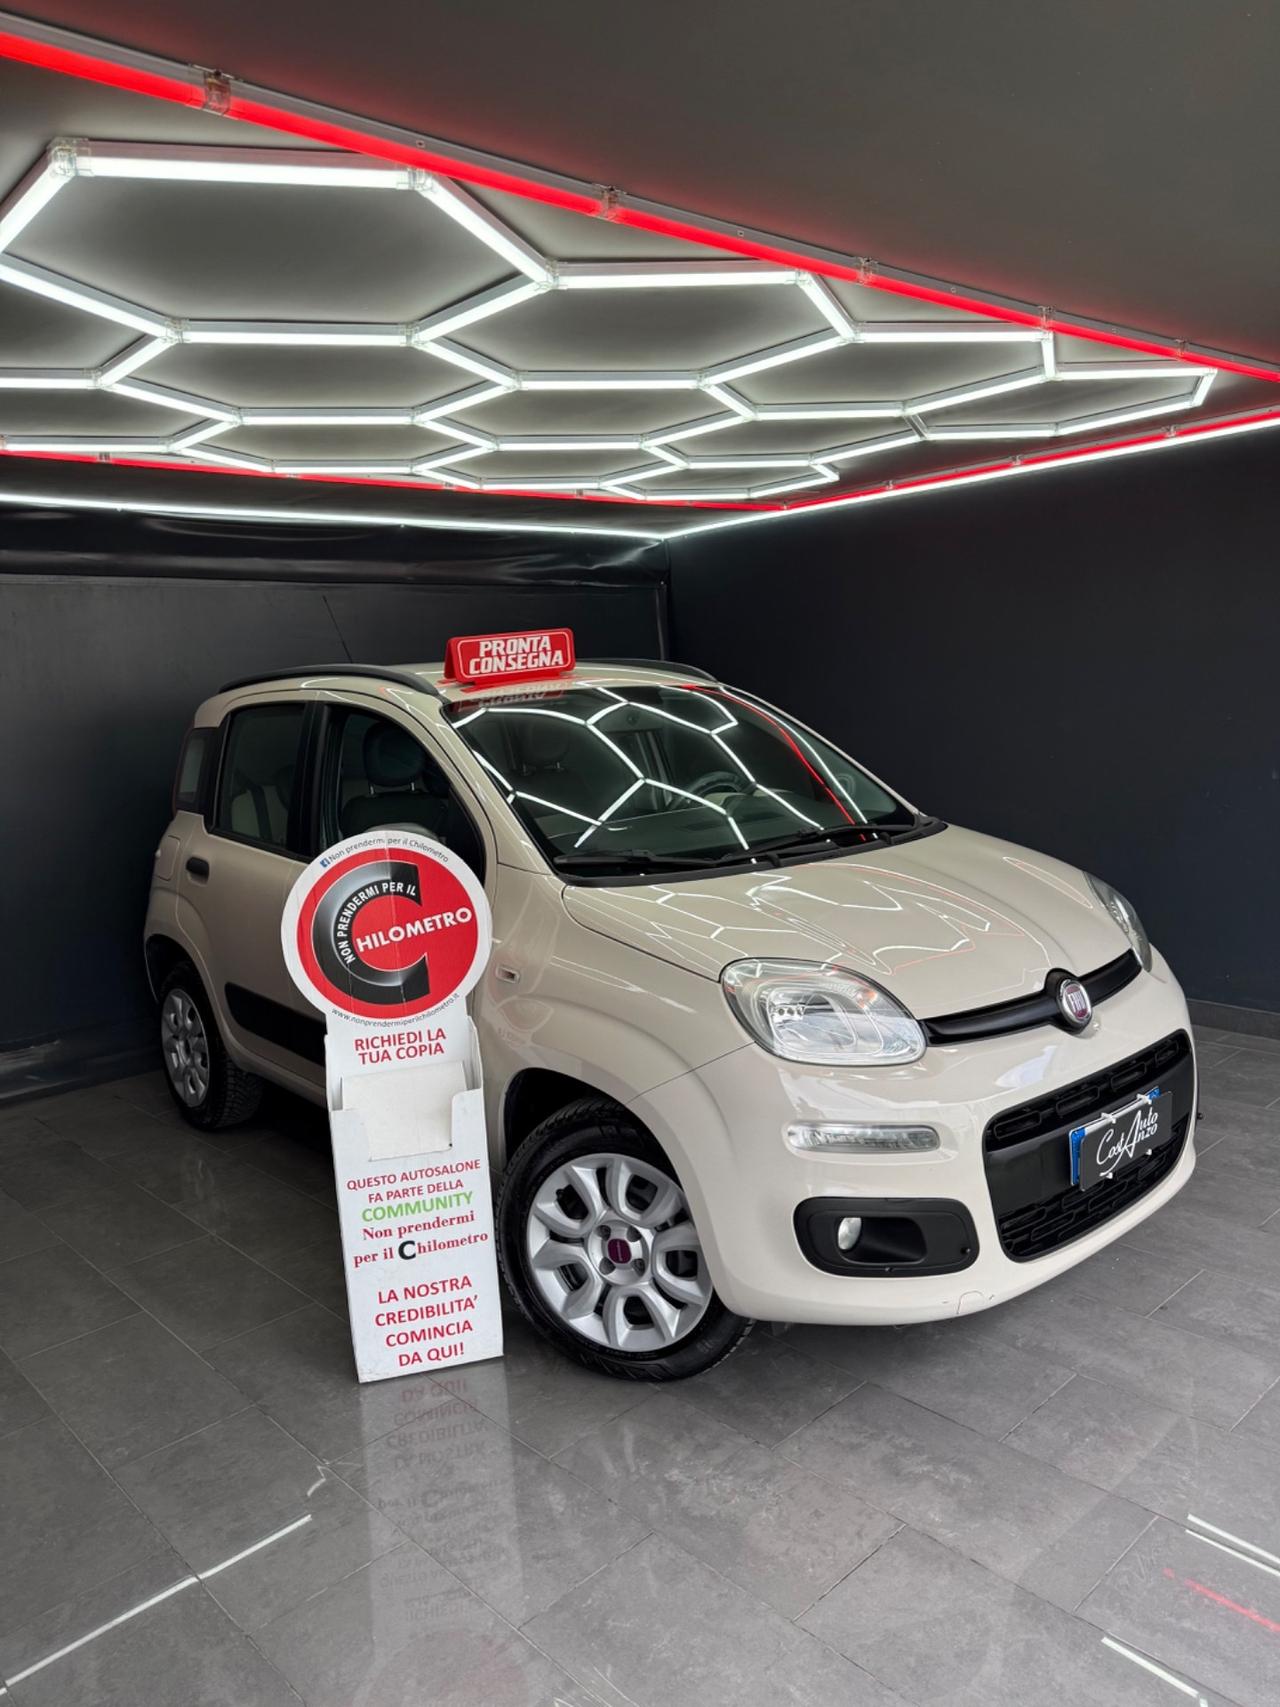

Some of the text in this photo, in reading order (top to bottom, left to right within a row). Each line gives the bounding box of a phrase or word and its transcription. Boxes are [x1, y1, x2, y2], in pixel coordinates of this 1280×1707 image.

[480, 635, 552, 657] PRONTA
[469, 650, 564, 675] CONSEGNA
[328, 850, 345, 862] Non
[409, 839, 449, 863] Chilometro
[336, 881, 417, 965] NON PRENDERMI PER IL
[354, 1027, 447, 1052] RICHIEDI LA
[358, 1042, 445, 1066] TUA COPIA
[346, 1159, 481, 1191] QUESTO AUTOSALONE
[367, 1179, 464, 1204] FA PARTE DELLA
[361, 1191, 474, 1223] COMMUNITY
[362, 1210, 475, 1241] Non prendermi
[353, 1232, 489, 1268] per il Chilometro
[377, 1275, 473, 1305] LA NOSTRA
[374, 1294, 479, 1327] CREDIBILITA'
[385, 1320, 473, 1348] COMINCIA
[398, 1342, 465, 1367] DA QUI!
